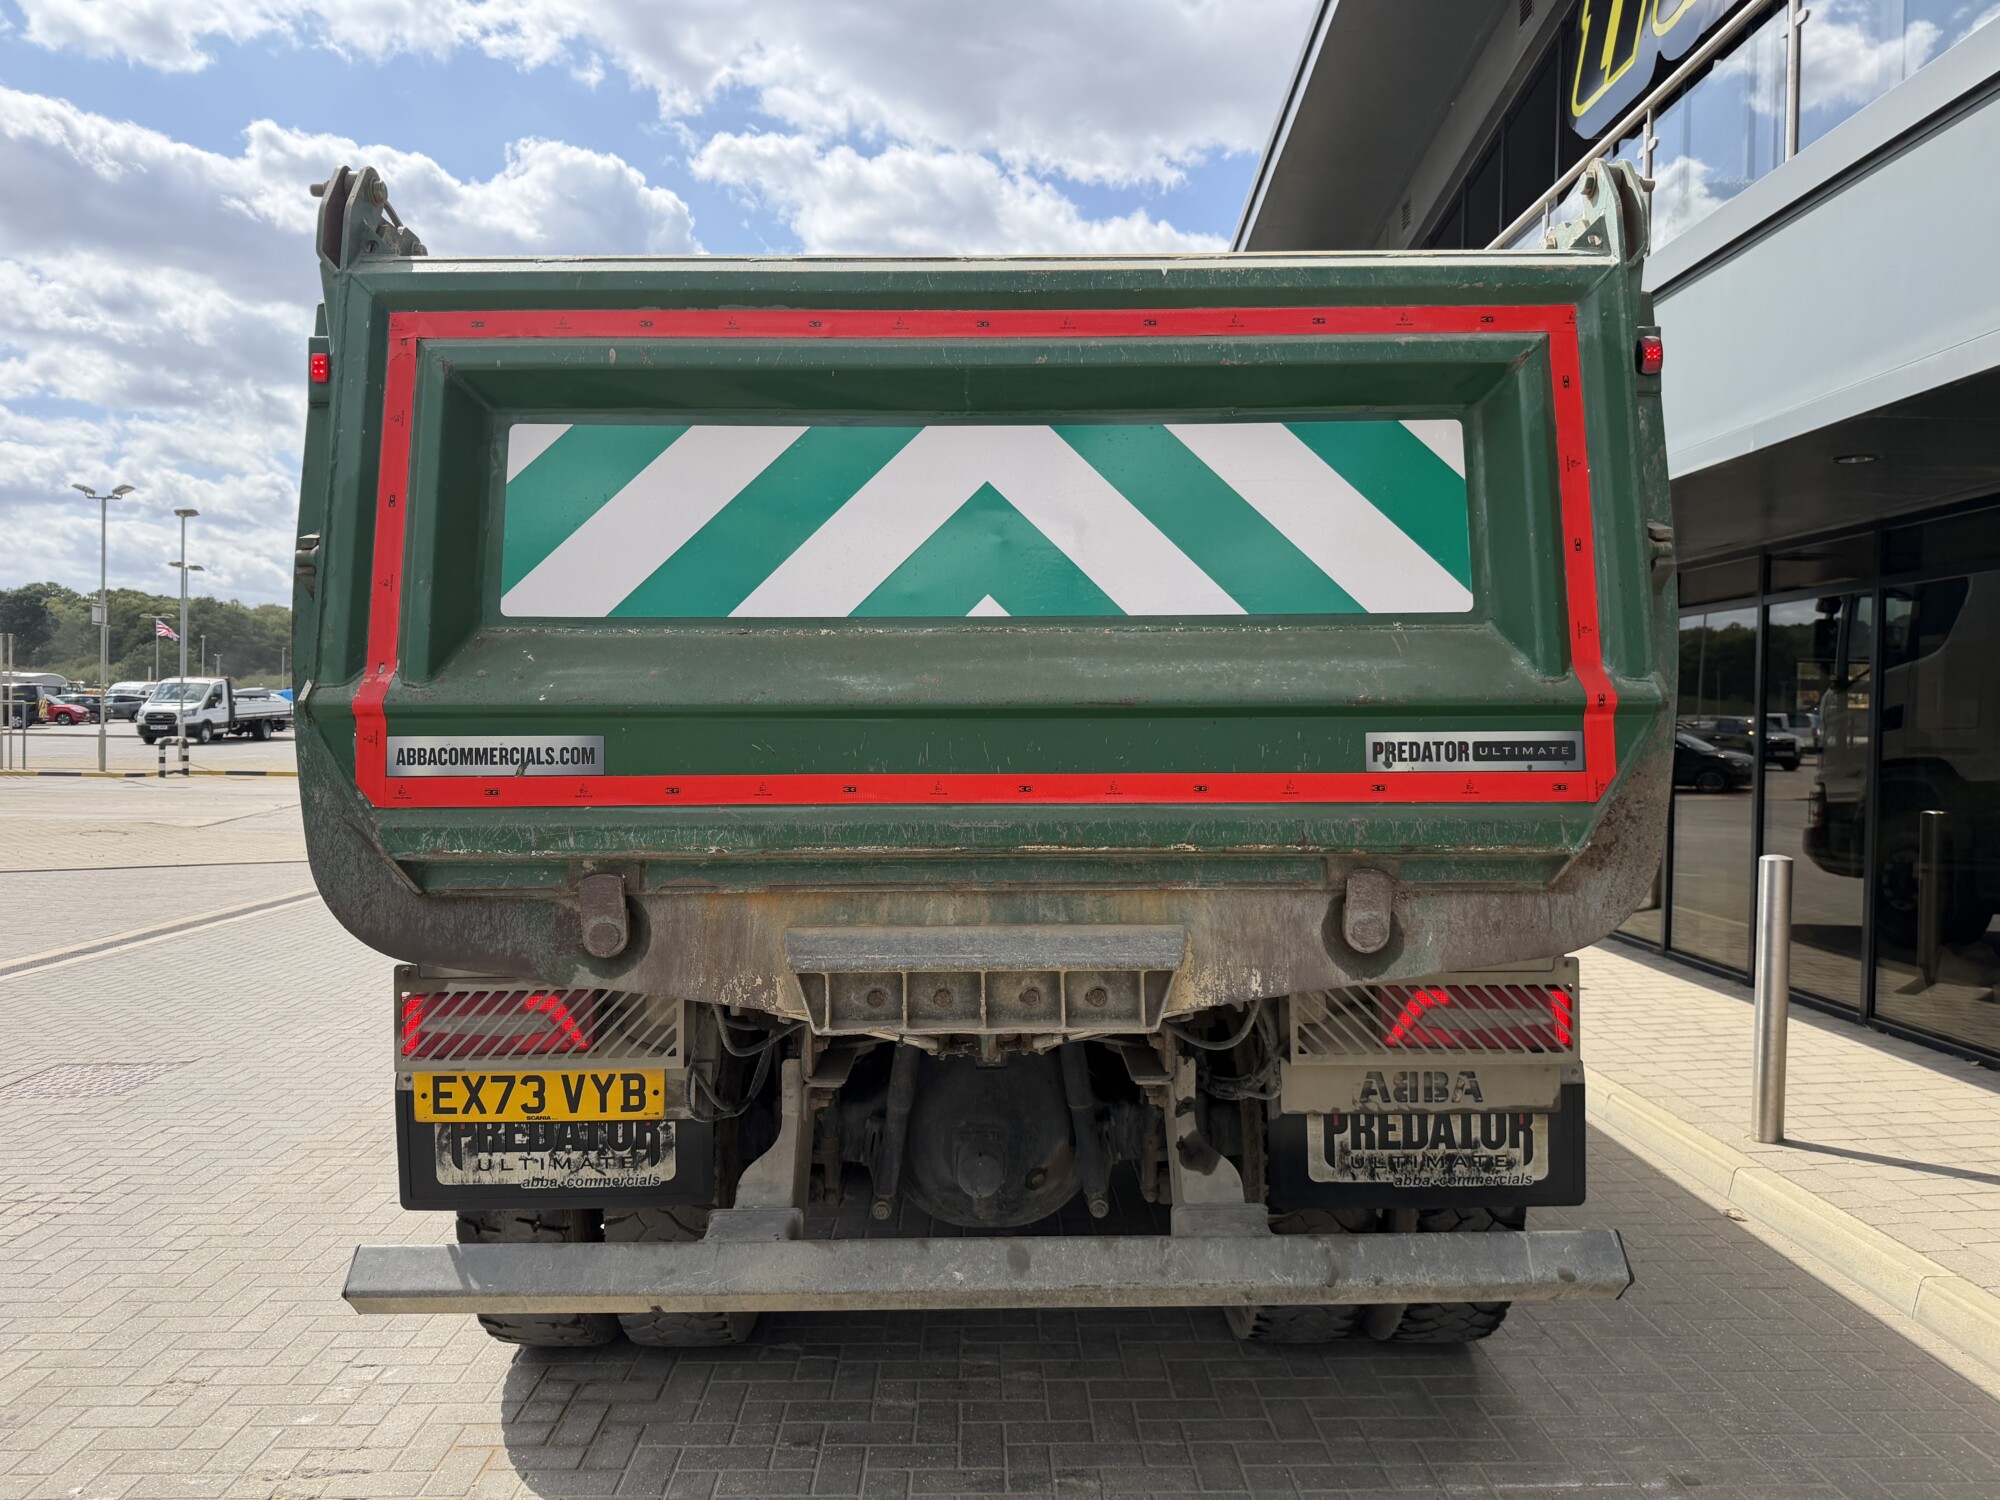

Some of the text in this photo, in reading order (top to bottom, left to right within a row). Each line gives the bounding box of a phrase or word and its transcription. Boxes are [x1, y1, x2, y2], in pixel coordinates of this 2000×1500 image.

[397, 747, 595, 765] ABBACOMMERCIALS.COM
[1373, 741, 1569, 762] PREDATOR ULTIMATE
[432, 1073, 646, 1115] EX73 VYB
[1359, 1070, 1484, 1103] ABBA
[478, 1156, 635, 1172] ULTIMATE
[1350, 1154, 1508, 1169] ULTIMATE
